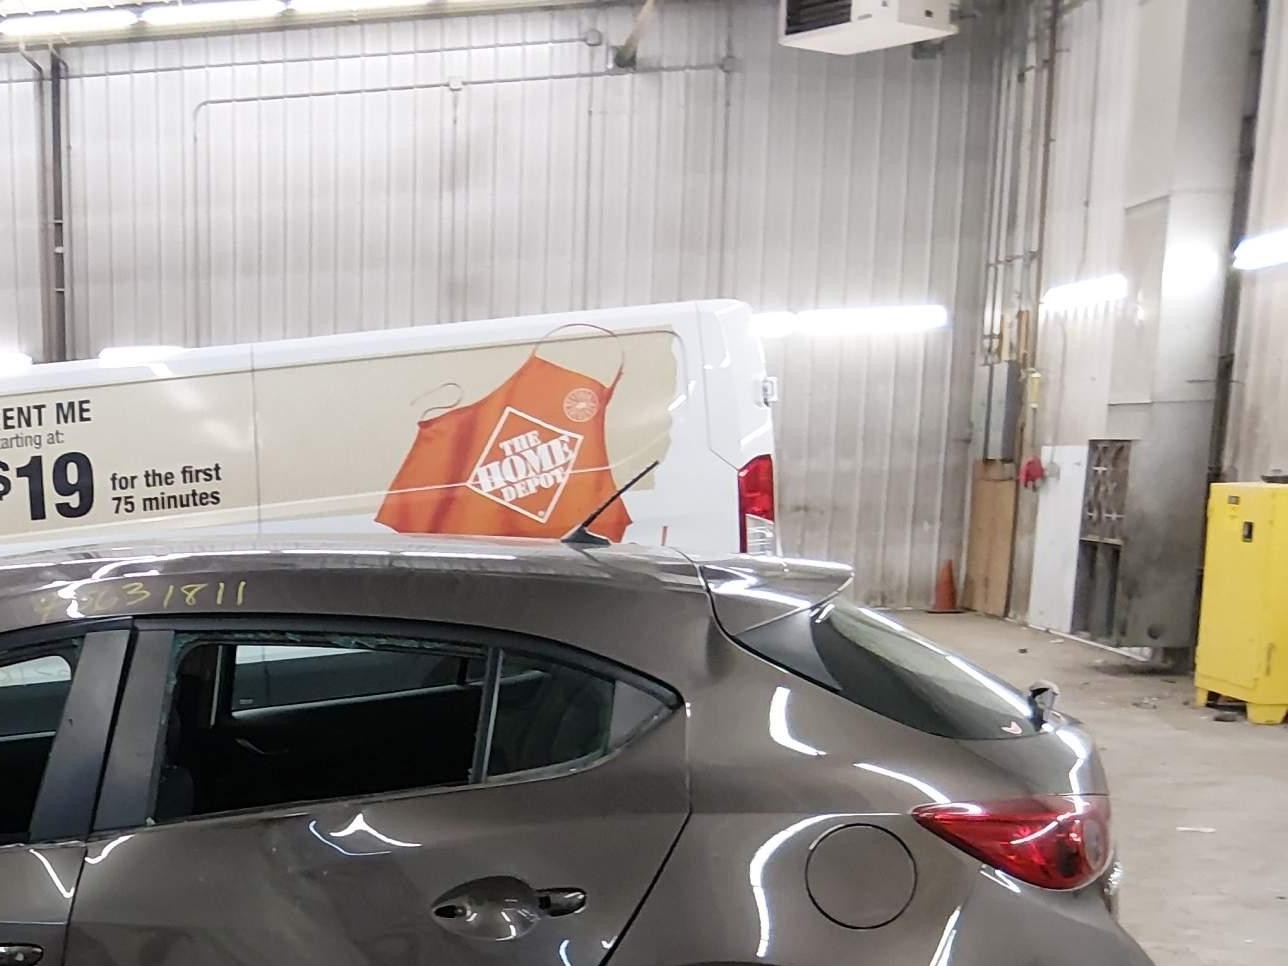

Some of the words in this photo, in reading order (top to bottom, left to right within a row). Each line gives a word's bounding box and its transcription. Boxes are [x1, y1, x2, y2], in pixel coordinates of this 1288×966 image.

[55, 399, 92, 425] ME
[46, 429, 65, 446] at:
[498, 430, 542, 457] THE
[110, 472, 138, 491] for
[144, 469, 175, 488] the
[180, 463, 223, 485] first
[476, 434, 573, 493] HOME
[500, 466, 565, 502] DEPOT
[111, 495, 136, 515] 75
[142, 488, 221, 513] minutes
